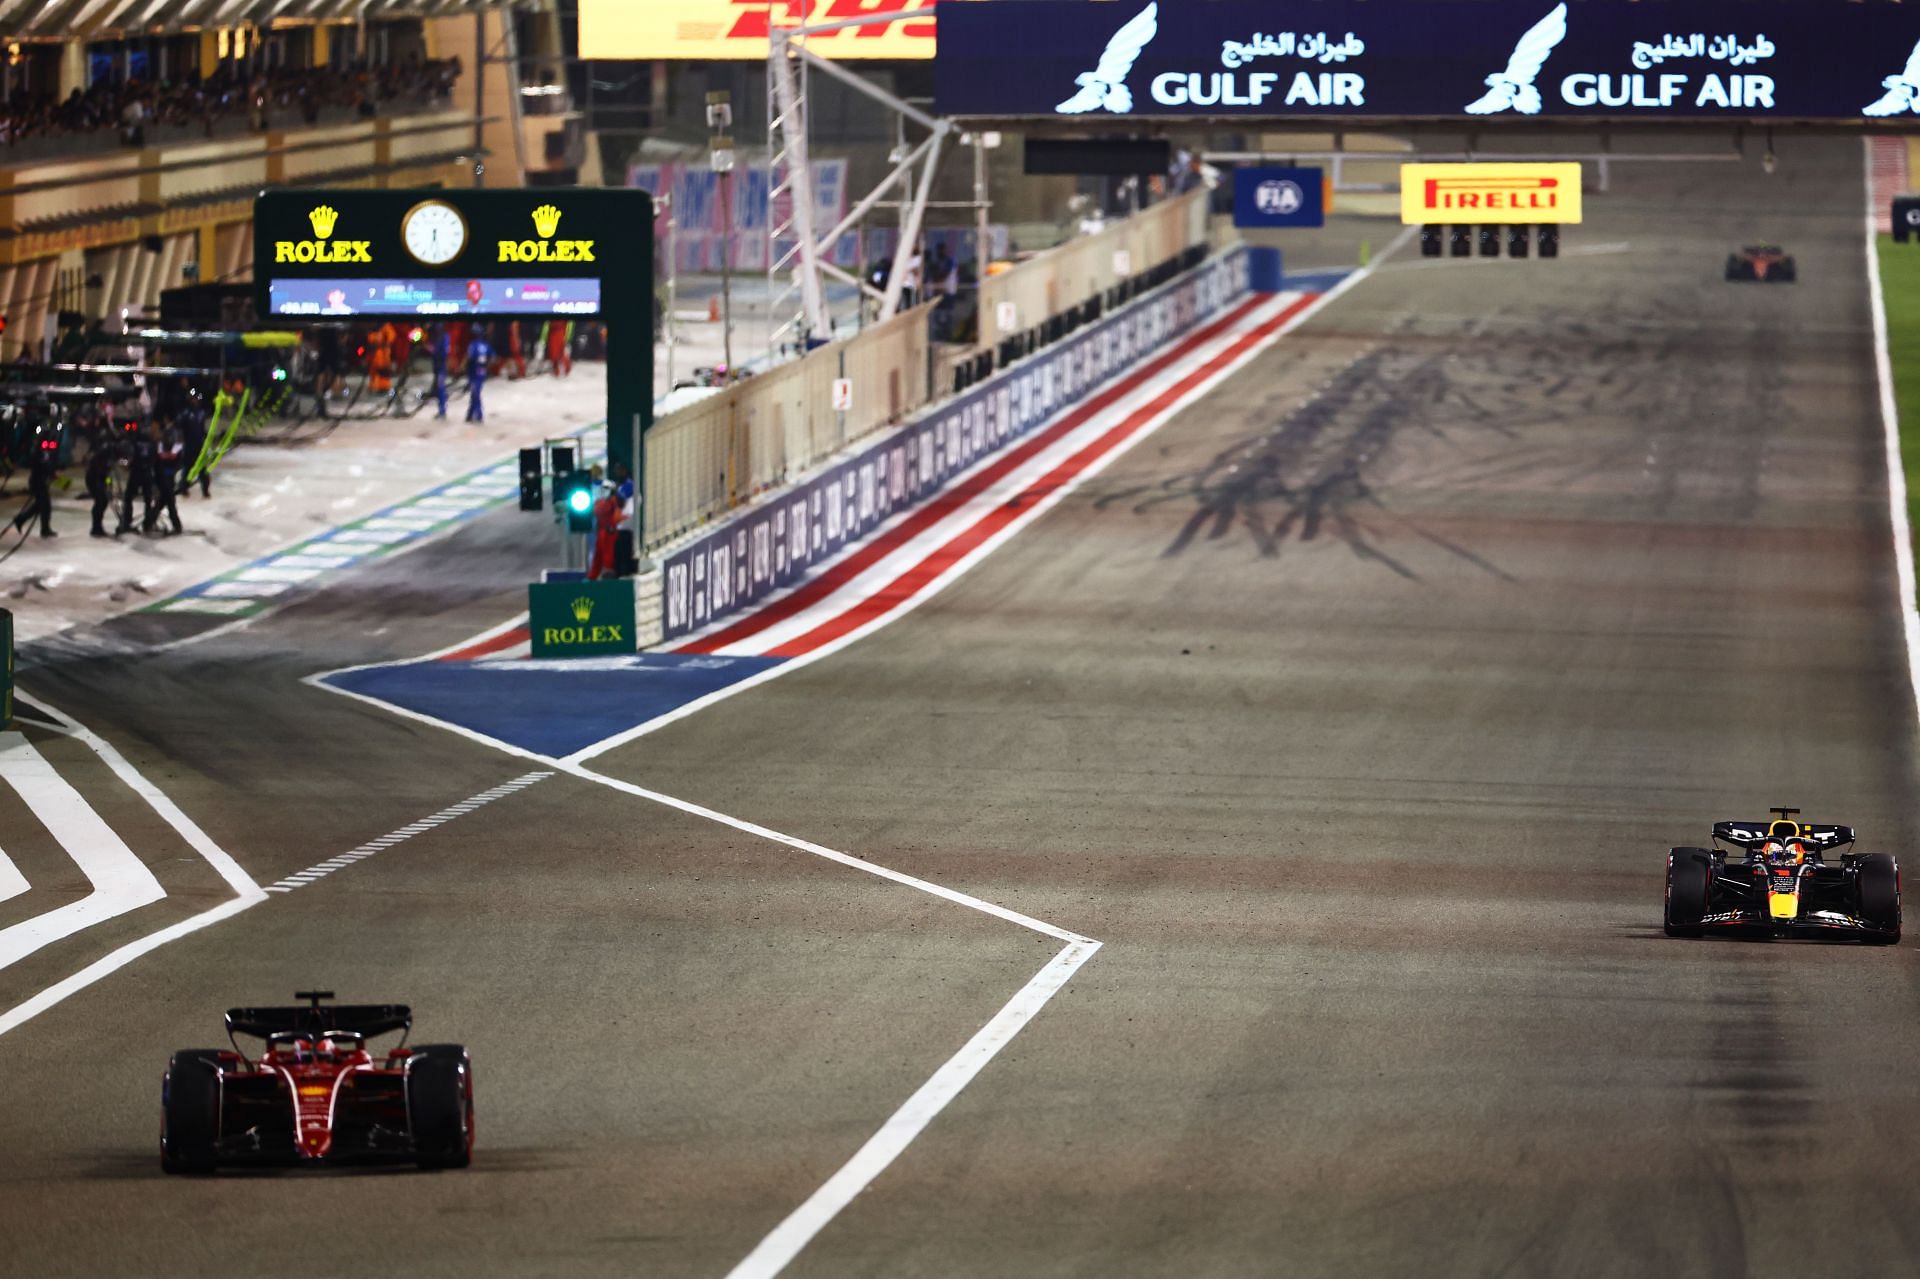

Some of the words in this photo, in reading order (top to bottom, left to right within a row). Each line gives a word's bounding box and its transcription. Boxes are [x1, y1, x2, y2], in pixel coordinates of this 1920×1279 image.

[1220, 31, 1295, 68] الخليج
[1297, 31, 1365, 64] طيران
[1631, 34, 1705, 69] الخليج
[1708, 34, 1776, 66] طيران
[1151, 72, 1278, 106] GULF
[1285, 71, 1366, 106] AIR
[1561, 73, 1688, 107] GULF
[1696, 73, 1776, 108] AIR
[1256, 186, 1299, 210] FIA
[1424, 178, 1559, 208] PIRELLI
[275, 240, 373, 263] ROLEX
[497, 240, 596, 263] ROLEX
[543, 624, 624, 646] ROLEX
